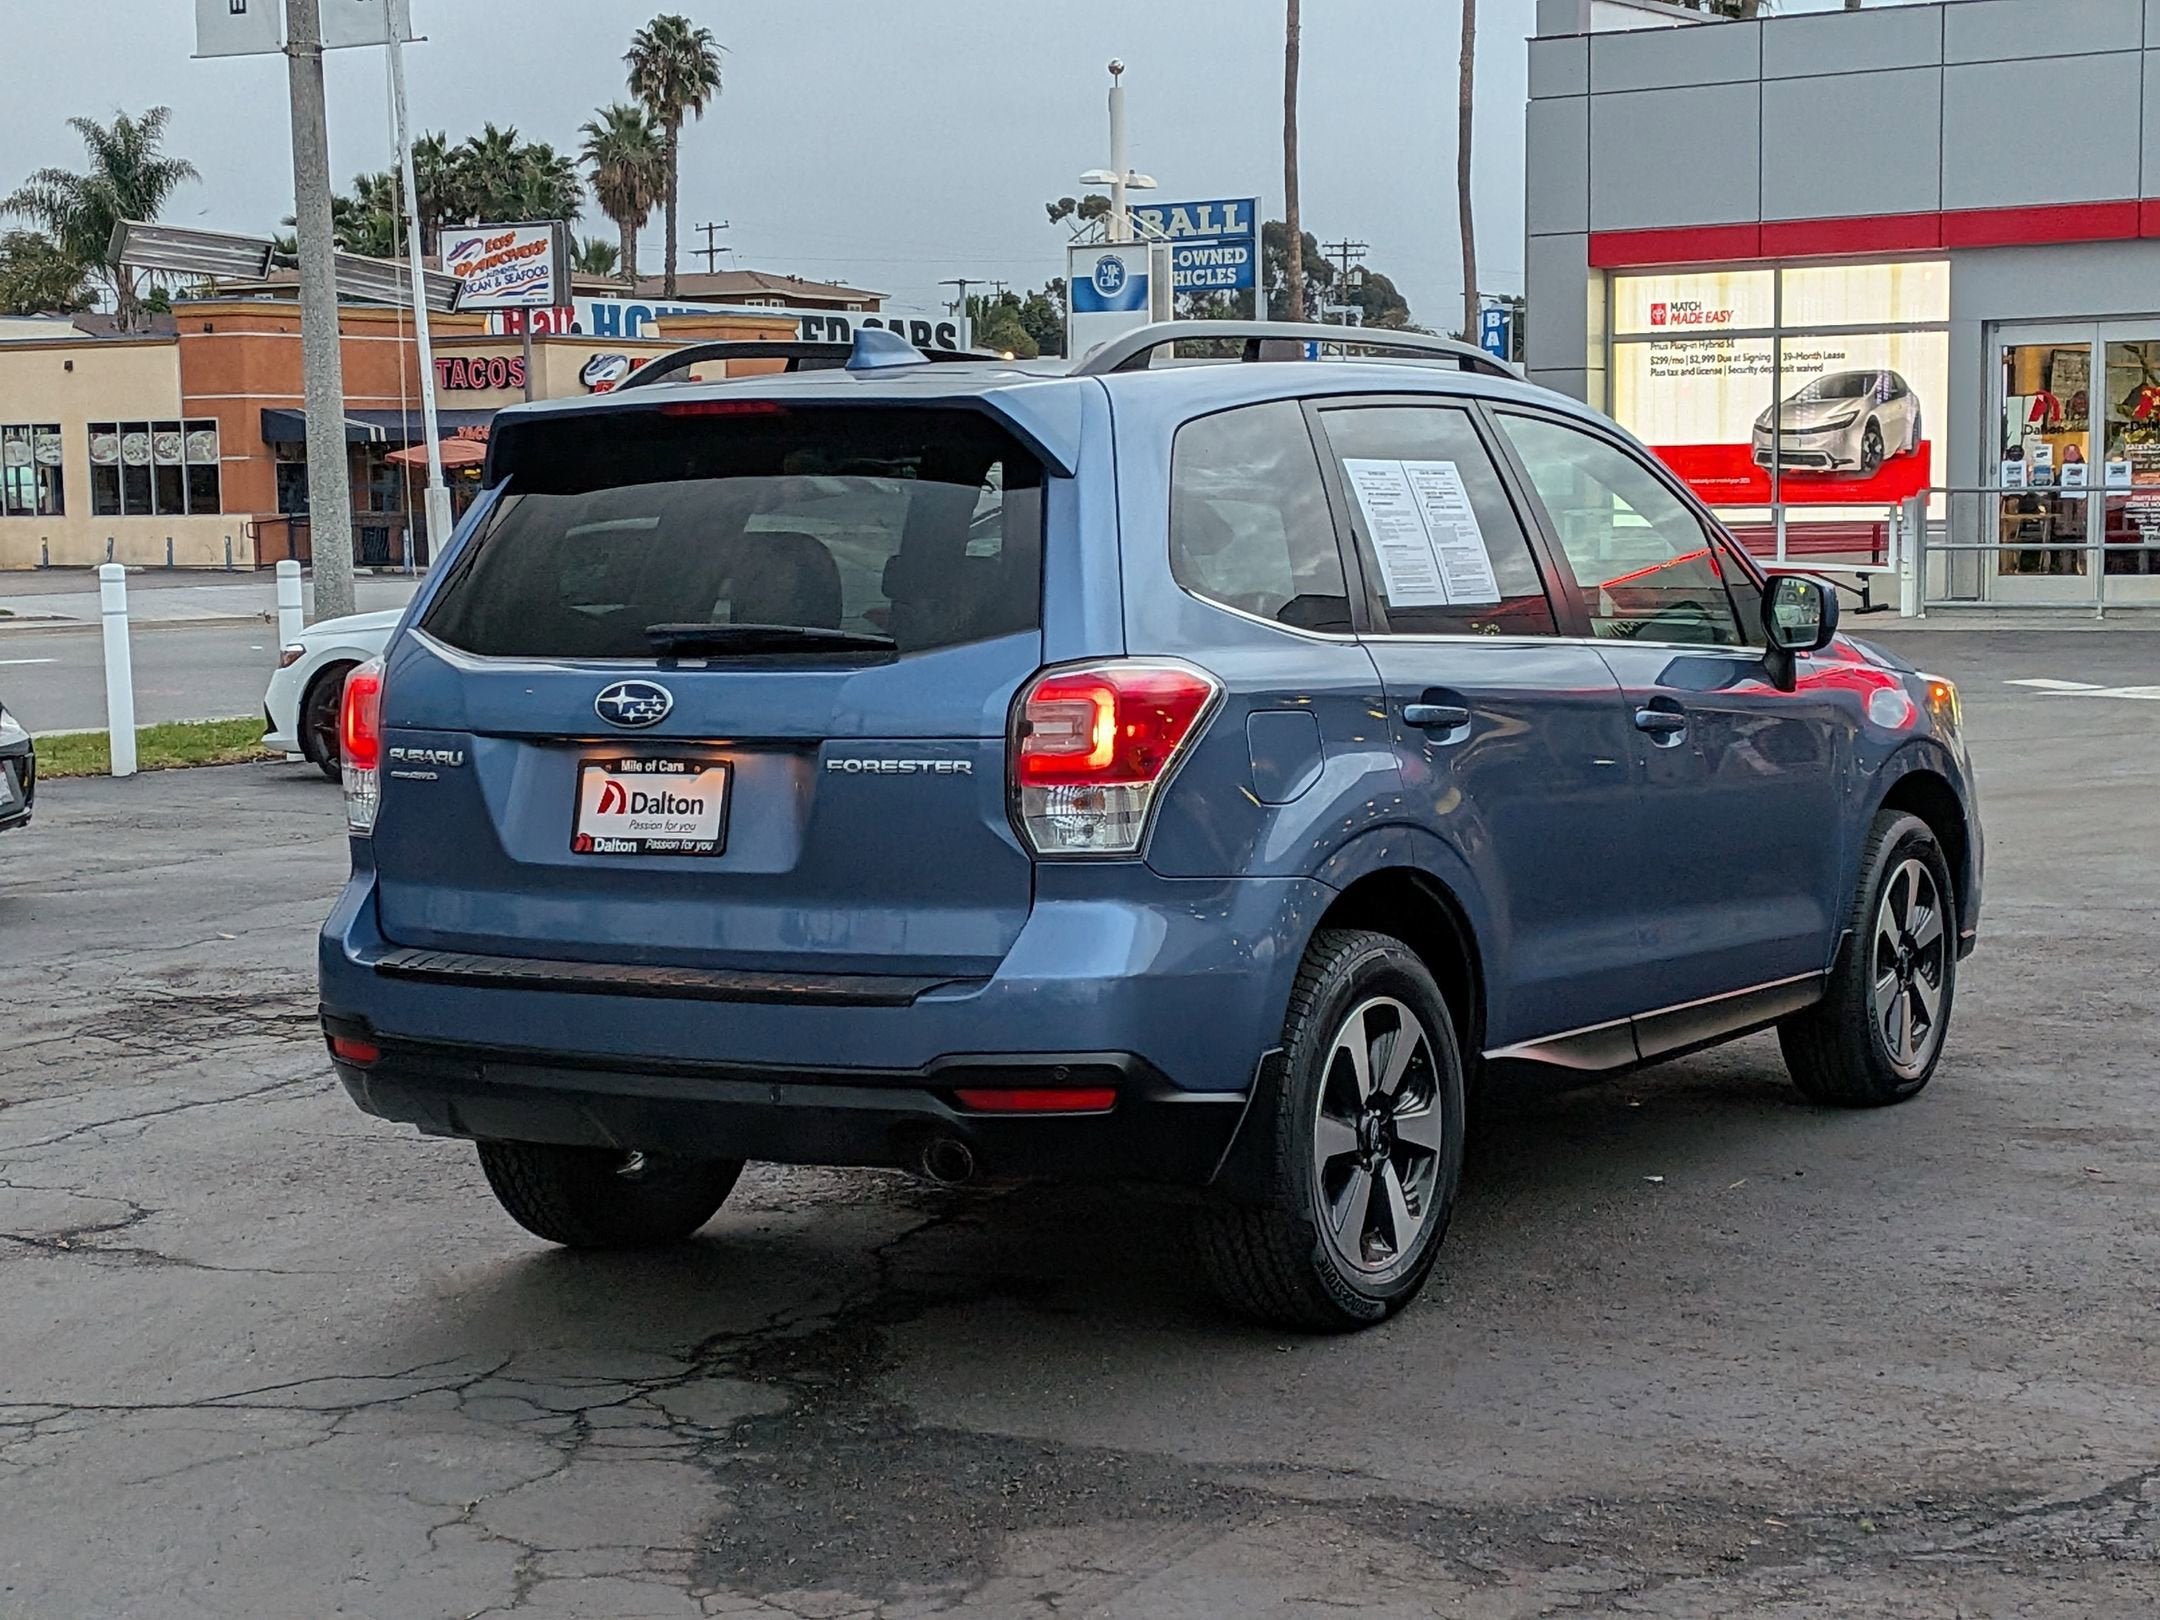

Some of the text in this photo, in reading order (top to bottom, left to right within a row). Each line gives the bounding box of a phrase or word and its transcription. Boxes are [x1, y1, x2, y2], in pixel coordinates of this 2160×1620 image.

[1138, 204, 1248, 238] BALL
[1173, 247, 1248, 268] -OWNED
[463, 265, 549, 295] XICAN & SEAFOOD
[1173, 267, 1237, 287] HICLES
[1670, 301, 1702, 312] MATCH
[1670, 310, 1735, 325] MADE EASY
[1650, 341, 1668, 351] Prius
[1670, 340, 1697, 352] Plug-in
[1699, 339, 1725, 351] Hybrid
[1650, 356, 1685, 366] $299/mo
[1717, 354, 1732, 363] Due
[1734, 353, 1740, 362] at
[1743, 352, 1771, 364] Signing
[1783, 351, 1822, 361] 39-Month
[1823, 351, 1845, 360] Lease
[435, 358, 525, 388] TACOS
[1650, 367, 1666, 377] Plus
[1667, 368, 1679, 376] tax
[1681, 367, 1695, 376] and
[1696, 366, 1722, 375] license
[1728, 364, 1758, 375] Security
[1796, 362, 1824, 373] waived
[389, 748, 464, 767] SUBARU
[621, 760, 685, 772] Mile of Cars
[827, 759, 973, 775] FORESTER
[631, 791, 704, 815] Dalton
[629, 819, 697, 832] Passion for you
[594, 838, 714, 852] Dalton Passion for you
